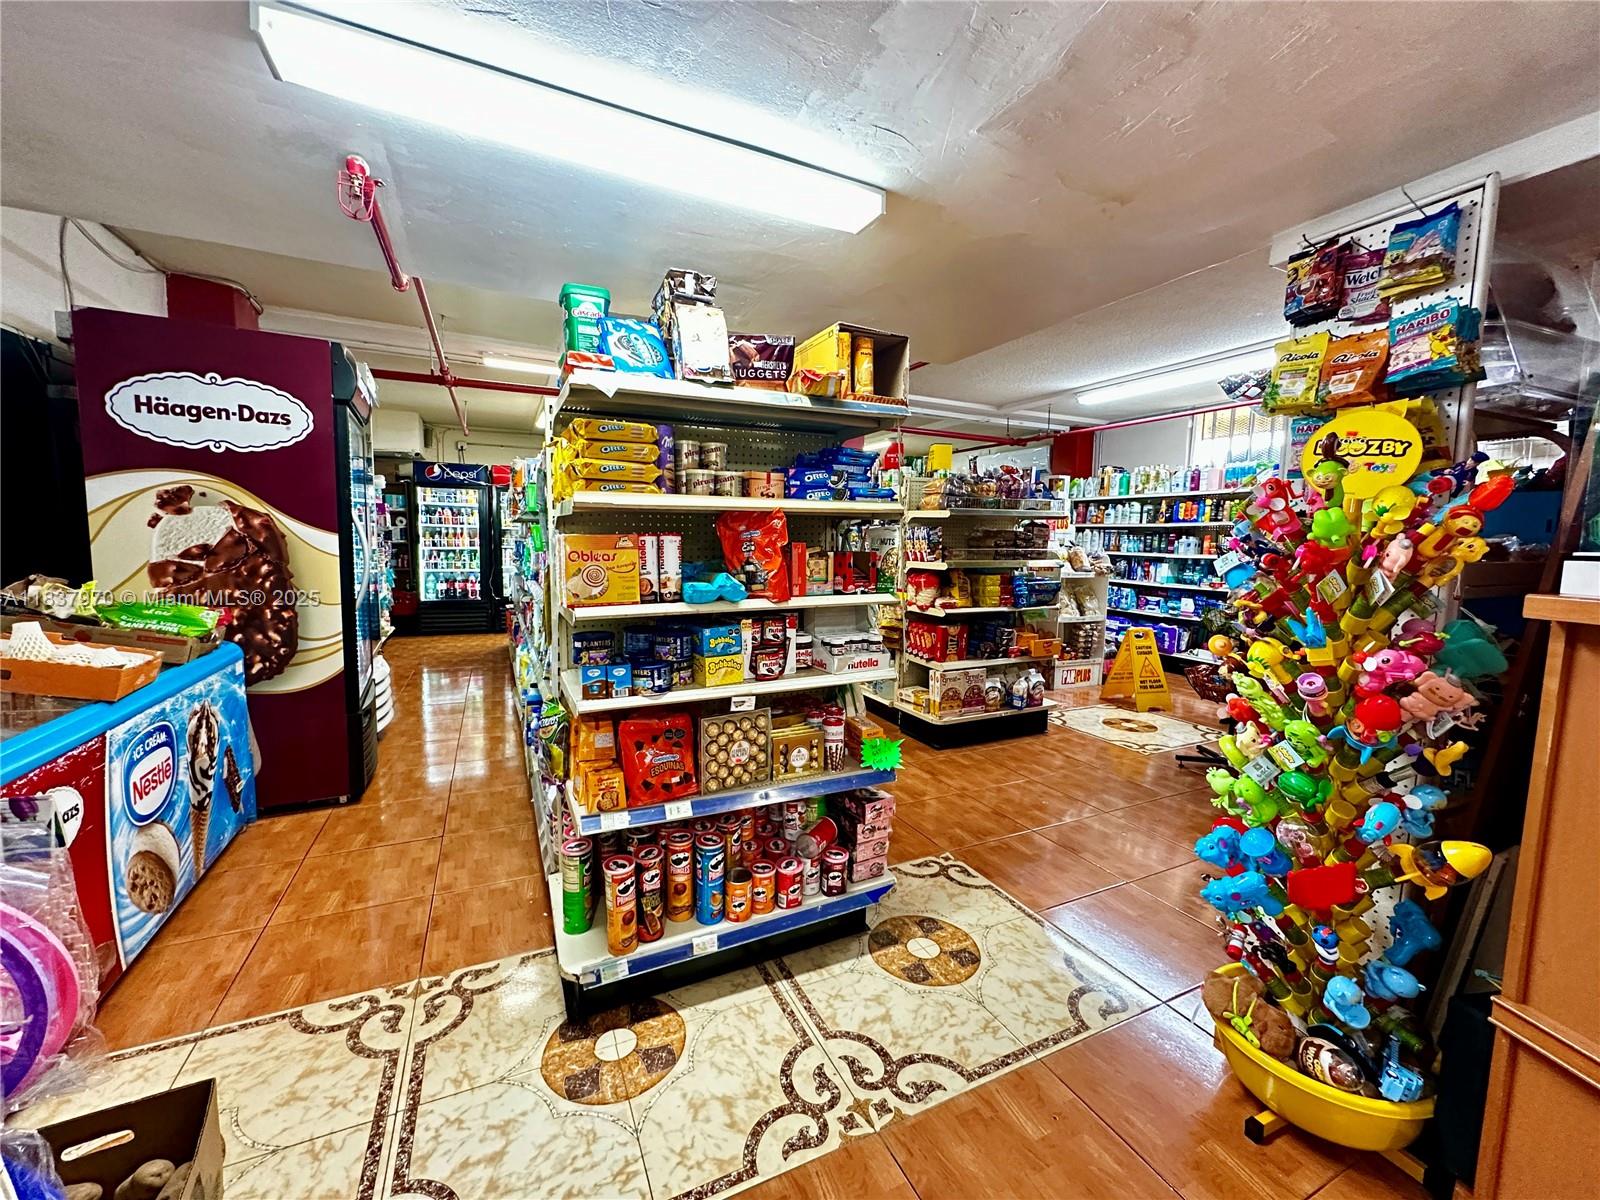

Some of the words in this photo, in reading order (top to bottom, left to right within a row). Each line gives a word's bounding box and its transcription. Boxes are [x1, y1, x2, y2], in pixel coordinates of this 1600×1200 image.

[1395, 308, 1451, 335] HARIBO
[1280, 351, 1320, 363] Ricola
[133, 394, 292, 426] Häagen-Dazs
[598, 423, 626, 433] OREO
[1296, 422, 1325, 434] HAR
[600, 445, 628, 454] OREO
[443, 466, 479, 480] pepsi
[599, 465, 627, 474] OREO
[1364, 462, 1398, 474] Toys
[804, 472, 829, 482] OREO
[600, 483, 627, 492] OREO
[806, 490, 831, 500] OREO
[1056, 518, 1069, 530] LUS
[568, 550, 618, 563] Obleas
[639, 539, 647, 571] nutella
[582, 639, 613, 649] PLANTERS
[709, 636, 737, 649] Bubbaloo
[708, 659, 741, 675] Bubbaloo
[848, 657, 879, 671] nutella
[1075, 668, 1092, 683] PLUS
[132, 743, 145, 762] ICE
[144, 731, 168, 752] CREAM
[650, 760, 686, 778] ESQUINAS
[132, 756, 172, 806] Nestlé
